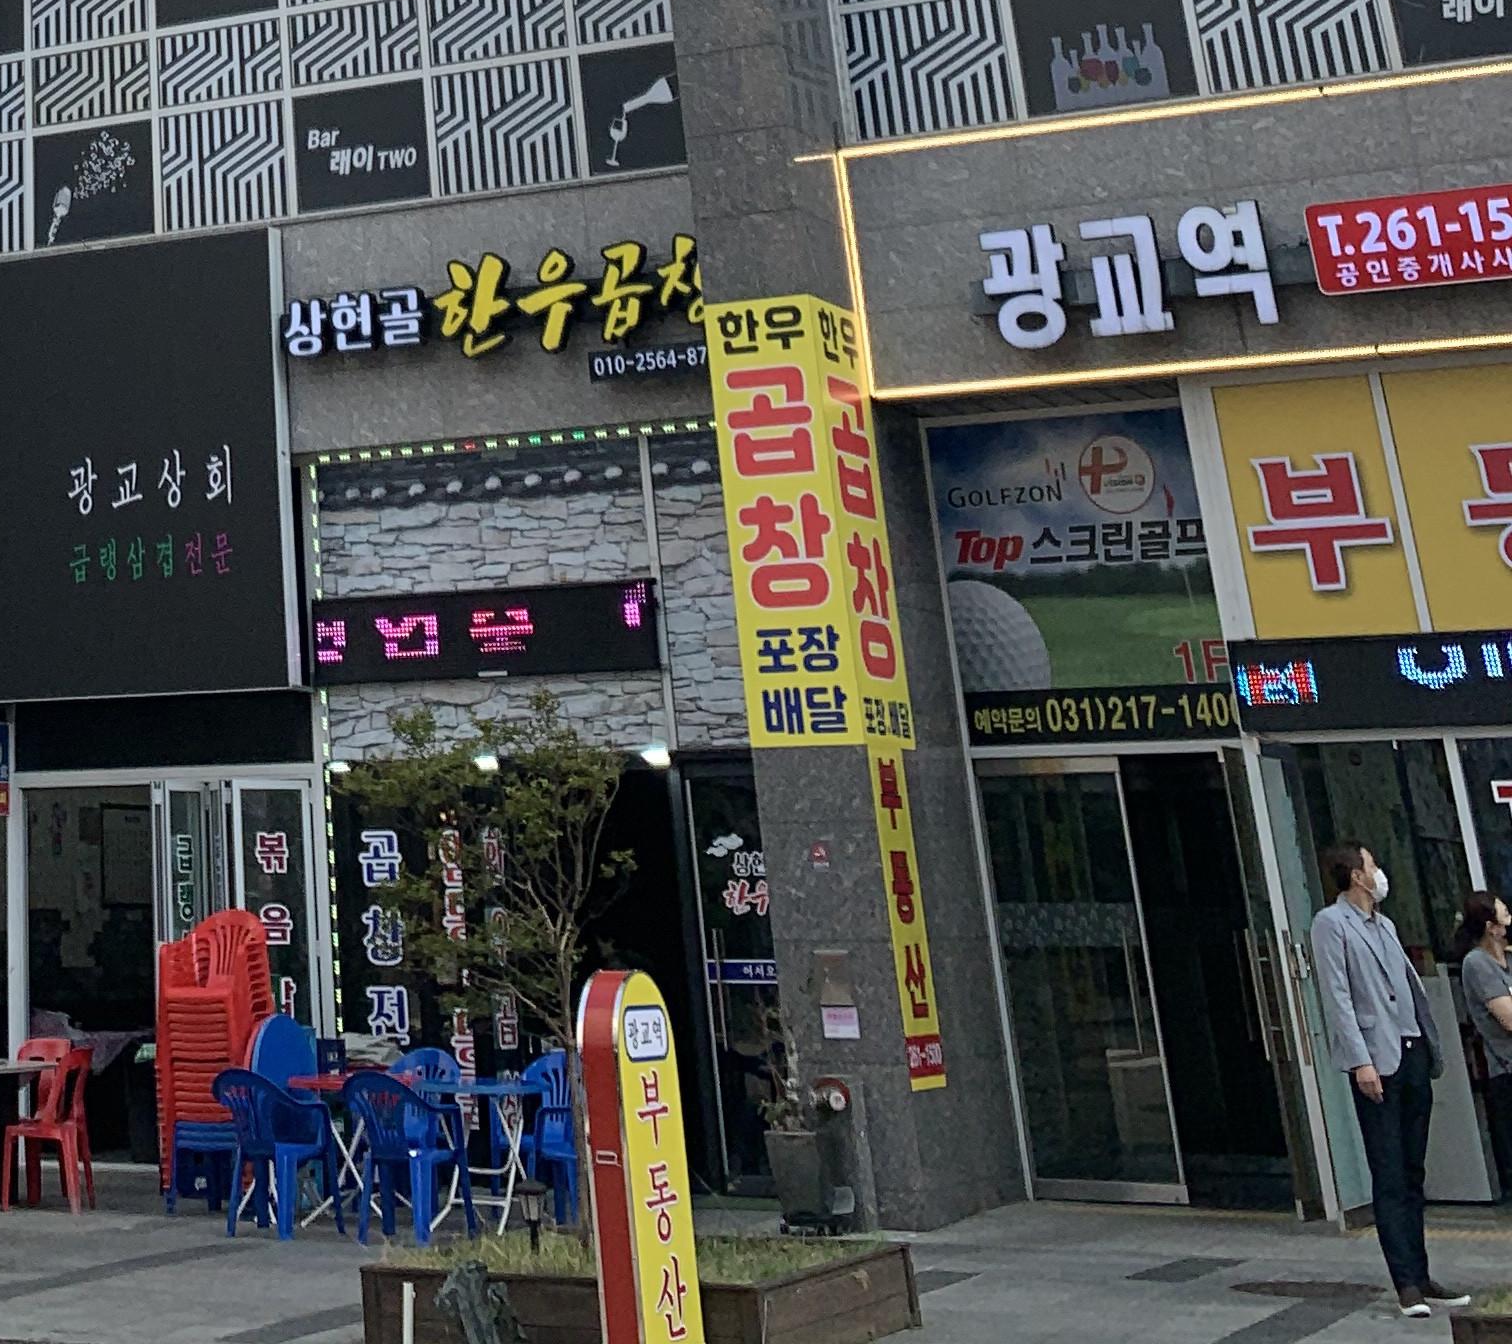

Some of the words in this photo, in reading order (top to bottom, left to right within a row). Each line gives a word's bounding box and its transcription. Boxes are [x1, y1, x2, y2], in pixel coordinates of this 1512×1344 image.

[307, 125, 341, 150] Bar
[329, 142, 375, 176] 래이
[377, 145, 418, 173] TWO
[978, 198, 1279, 351] 광교역
[285, 287, 424, 358] 상현골
[717, 304, 805, 356] 한우
[817, 306, 858, 370] 한우
[67, 443, 232, 515] 광교상회
[725, 365, 832, 609] 곱창
[947, 478, 1063, 509] GOLFZON
[826, 374, 897, 681] 곱창
[954, 529, 1025, 572] Top
[1029, 518, 1209, 565] 스크린골프
[756, 625, 840, 674] 포장
[761, 685, 849, 736] 배달
[973, 706, 1042, 735] 예약문의
[637, 1069, 688, 1340] 부동산
